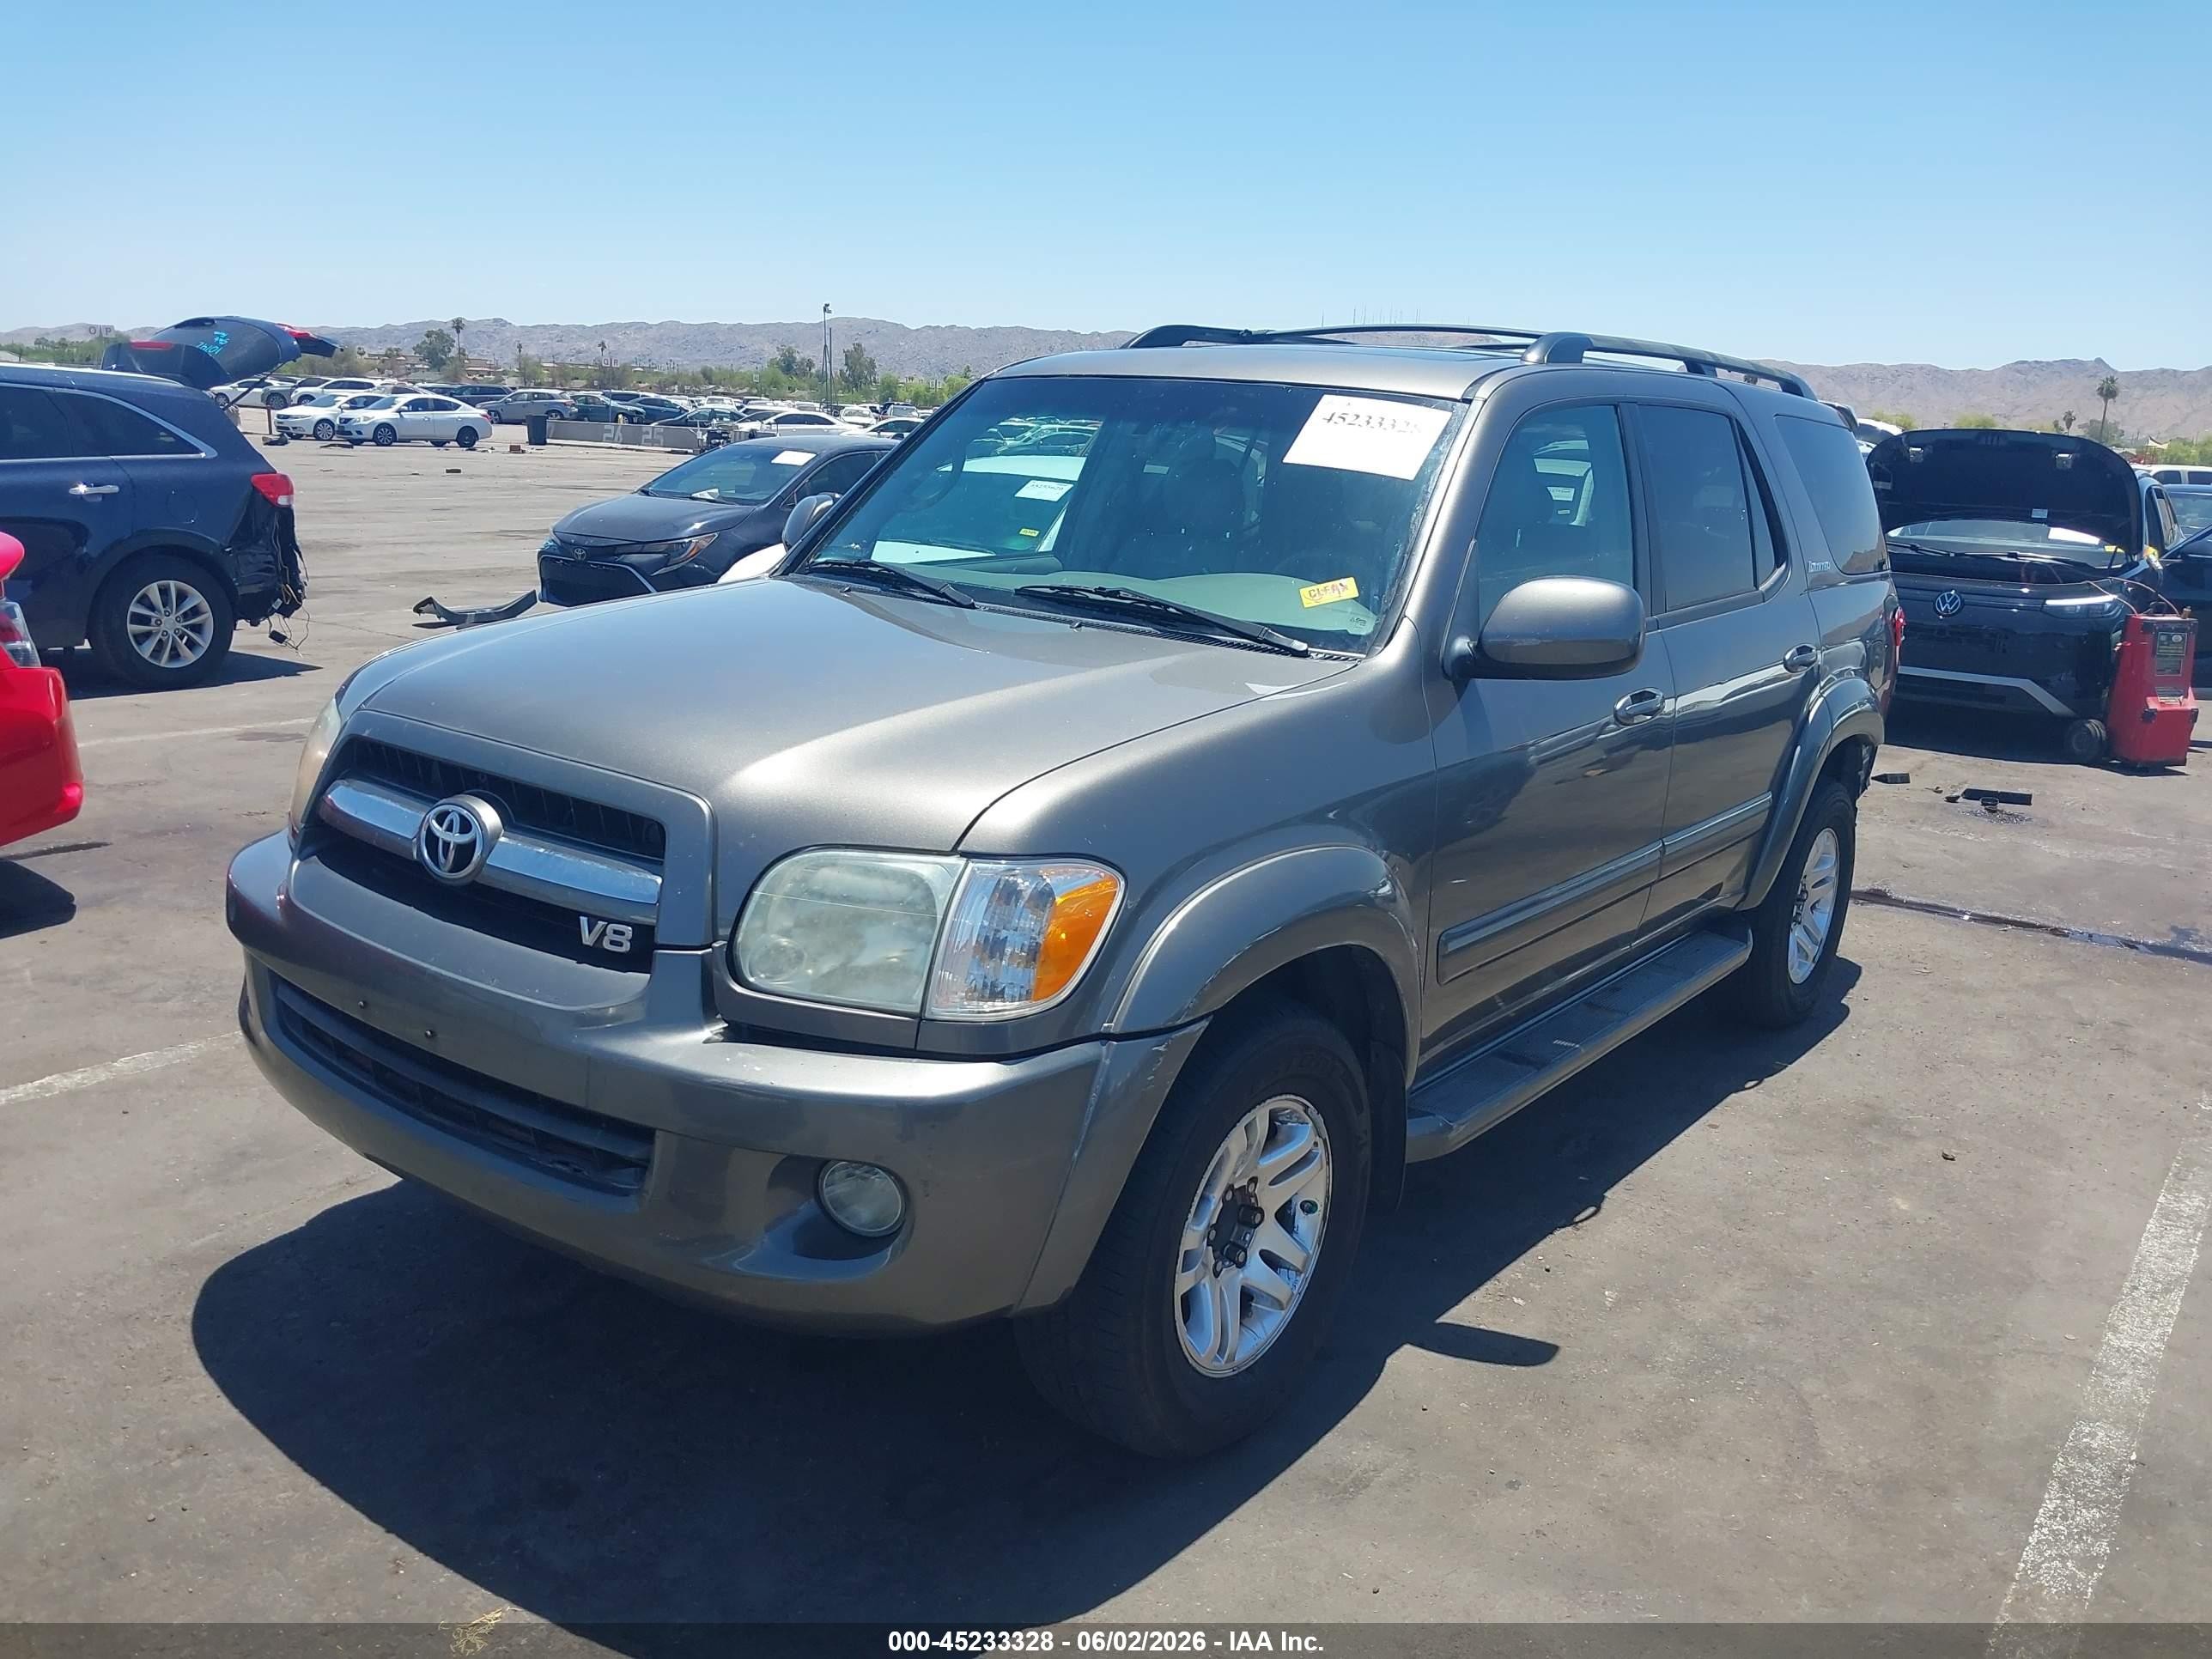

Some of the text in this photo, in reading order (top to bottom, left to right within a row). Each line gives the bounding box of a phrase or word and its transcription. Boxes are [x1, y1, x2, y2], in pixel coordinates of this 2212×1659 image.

[105, 327, 112, 336] P
[641, 427, 664, 446] 25
[579, 916, 633, 953] V8
